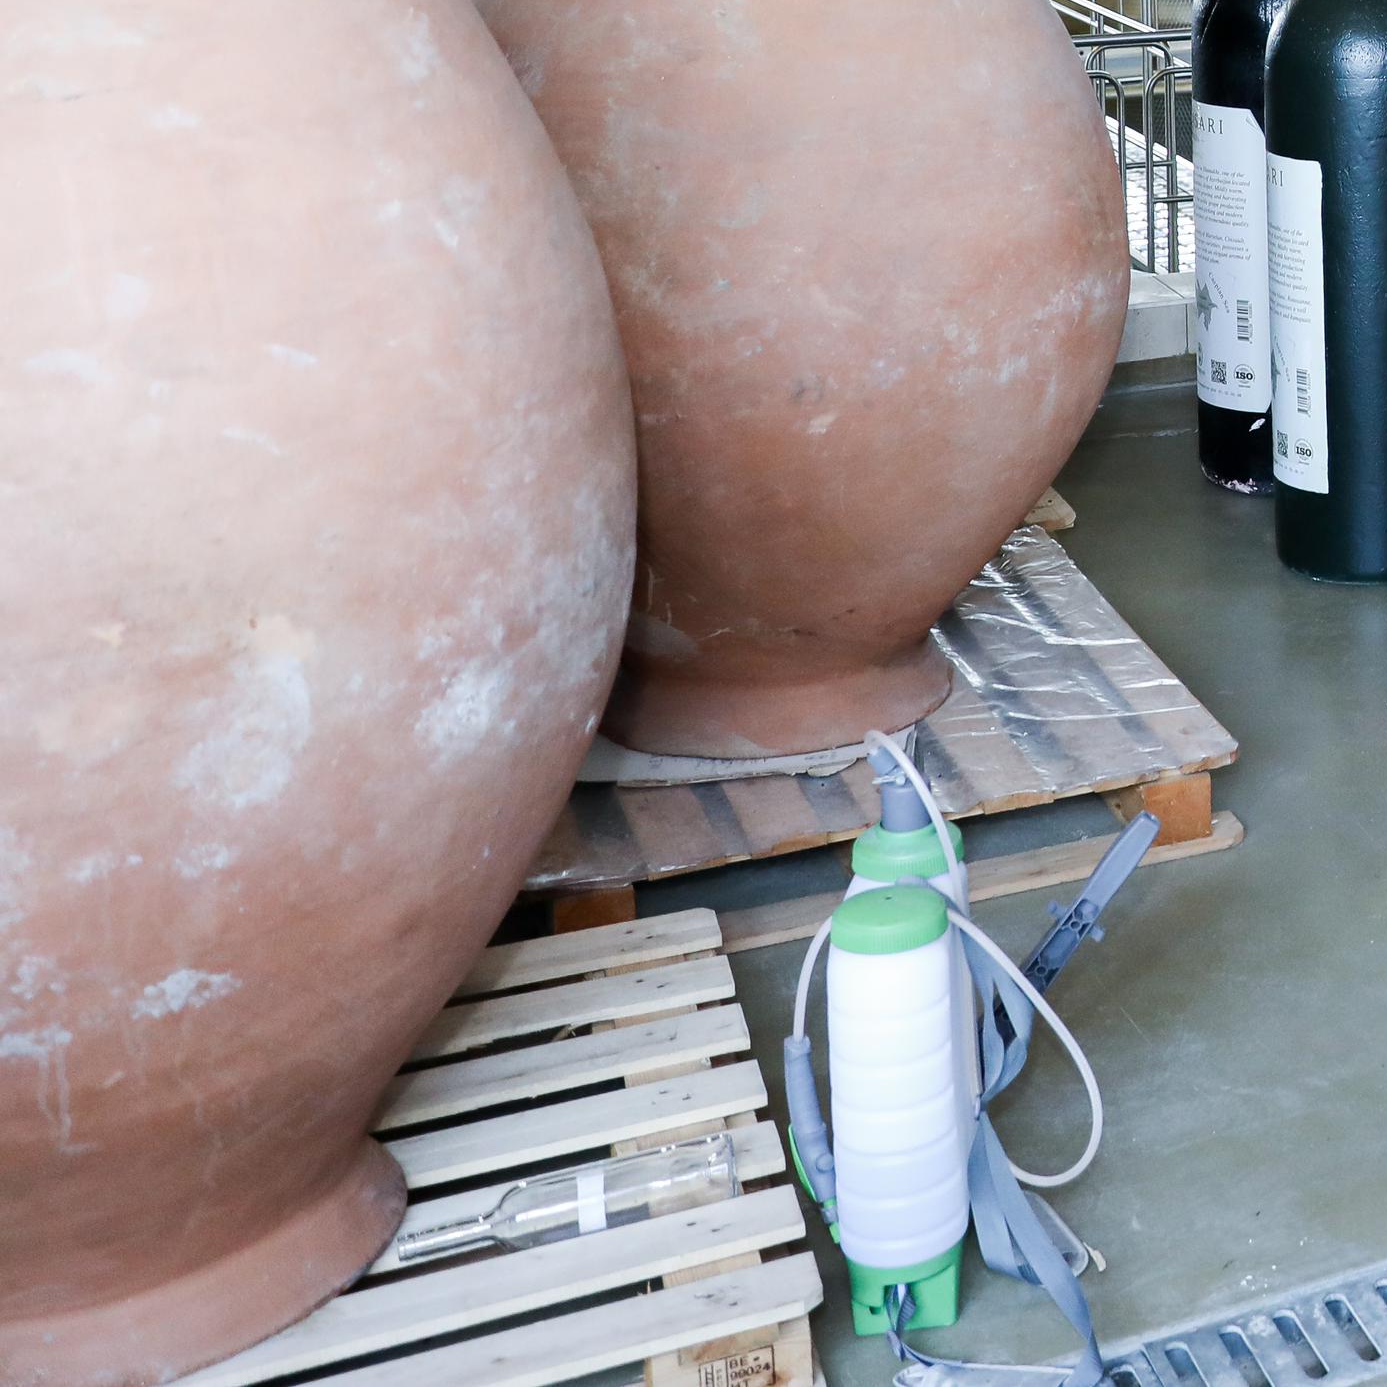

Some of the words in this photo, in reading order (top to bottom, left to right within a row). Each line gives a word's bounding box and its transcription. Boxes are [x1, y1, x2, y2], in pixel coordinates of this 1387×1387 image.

[1195, 117, 1223, 133] SARI
[1235, 371, 1253, 380] ISO
[1295, 446, 1311, 457] ISO
